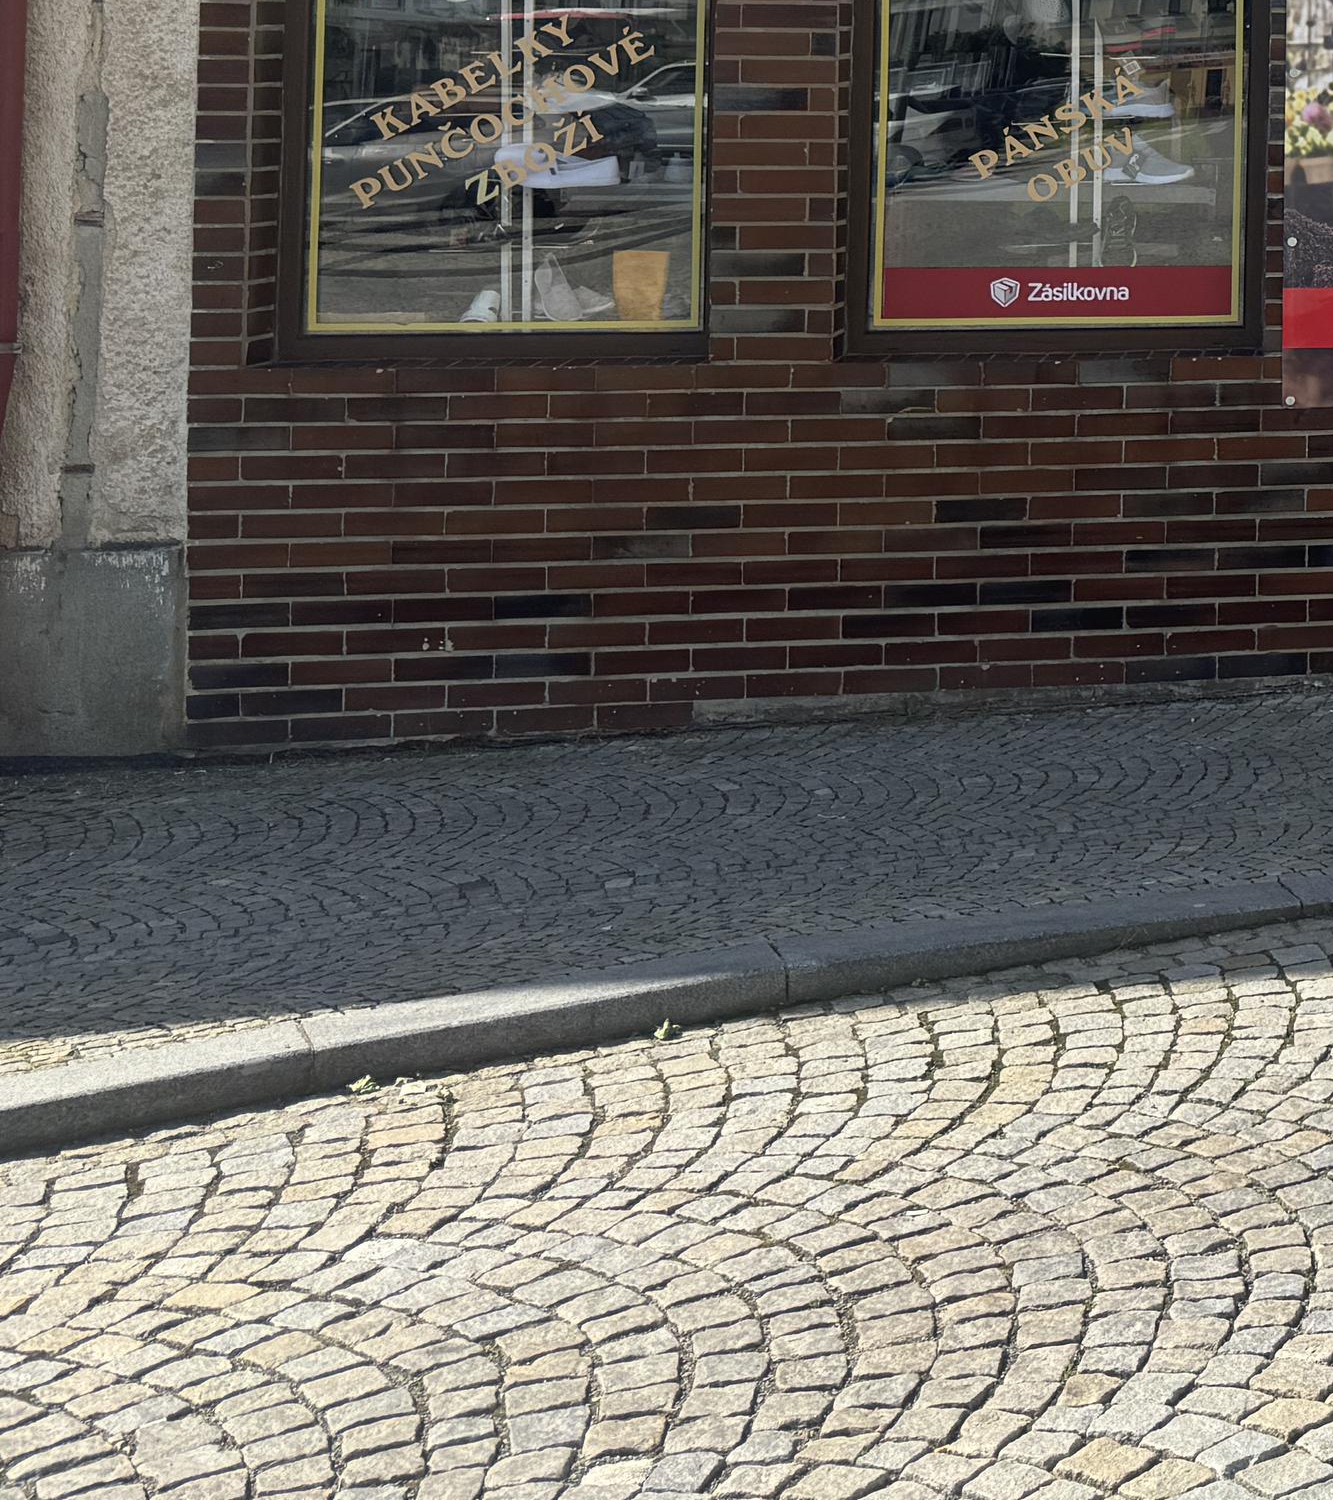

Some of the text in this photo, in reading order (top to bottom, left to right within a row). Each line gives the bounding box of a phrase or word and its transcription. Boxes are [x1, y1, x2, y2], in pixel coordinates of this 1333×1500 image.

[348, 27, 656, 210] PUNČOCHOVÉ
[369, 13, 578, 141] KABELKY
[968, 66, 1145, 181] PÁNSKÁ
[464, 110, 604, 206] ZBOŽÍ
[1026, 126, 1137, 202] OBUV
[1027, 282, 1130, 302] Zásilkovna
